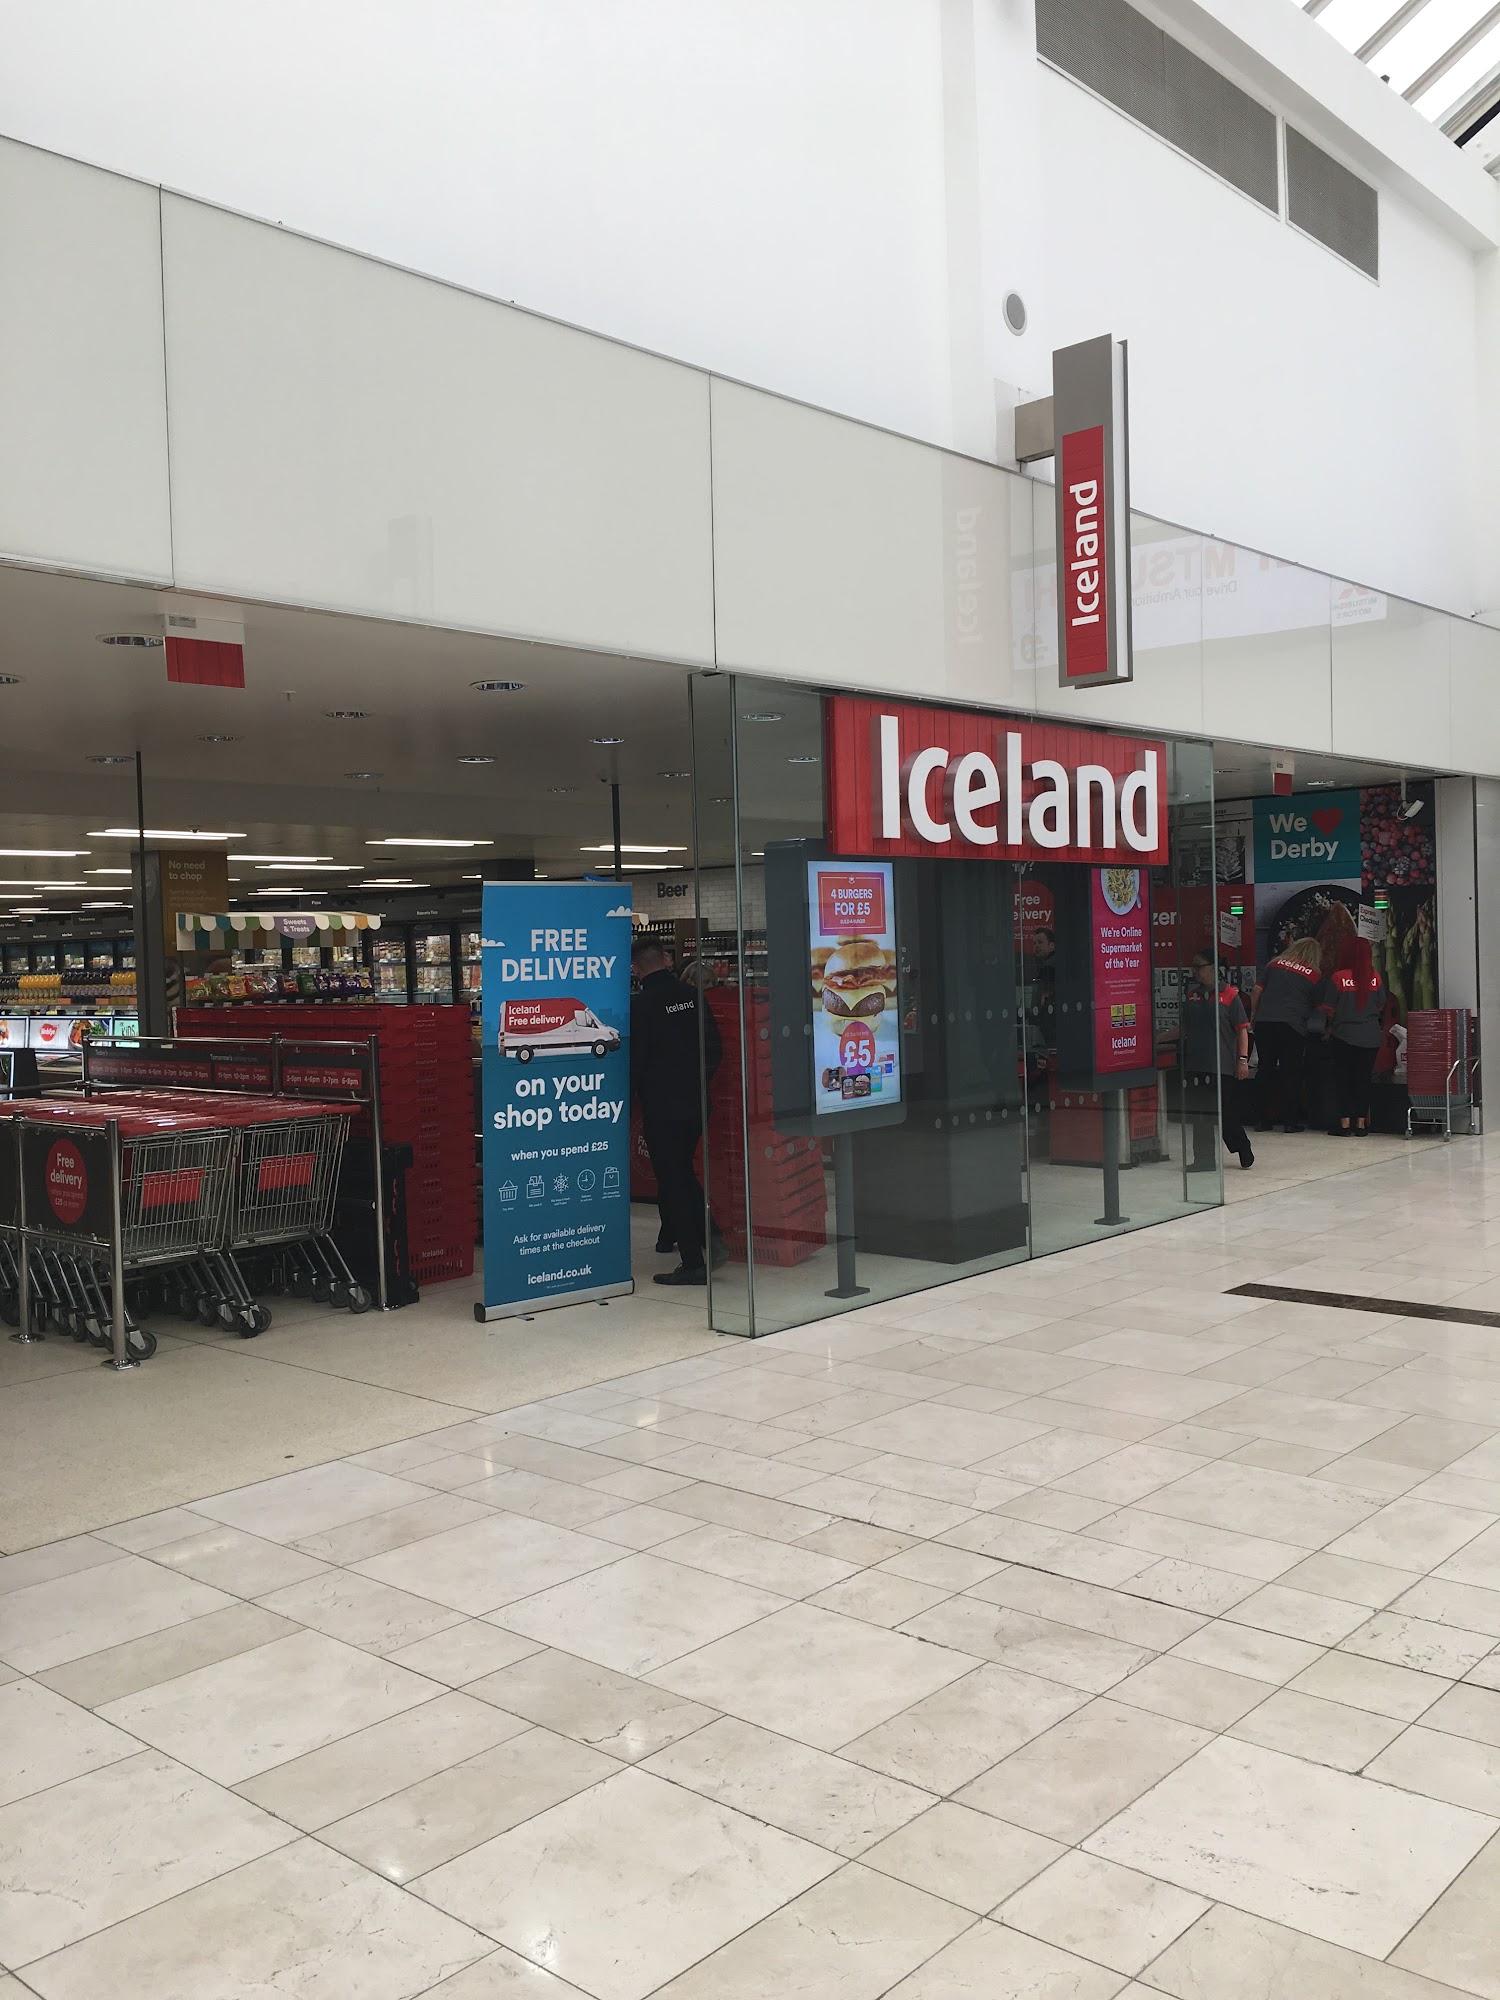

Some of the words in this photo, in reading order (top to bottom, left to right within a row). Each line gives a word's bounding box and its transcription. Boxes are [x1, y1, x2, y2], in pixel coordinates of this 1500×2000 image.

[1069, 479, 1100, 627] Iceland
[876, 714, 1159, 852] Iceland
[1269, 813, 1308, 834] We
[1270, 837, 1339, 861] Derby
[168, 860, 181, 869] No
[184, 861, 205, 870] need
[168, 872, 178, 880] to
[180, 872, 202, 882] chop
[657, 882, 688, 898] Beer
[830, 888, 837, 899] 4
[838, 888, 873, 899] BURGERS
[1014, 893, 1040, 906] Free
[834, 902, 855, 916] FOR
[857, 902, 871, 916] £5
[283, 918, 308, 926] Sweets
[1100, 927, 1120, 938] We're
[1120, 926, 1142, 938] Online
[531, 928, 588, 952] FREE
[1101, 942, 1142, 956] Supermarket
[501, 956, 617, 982] DELIVERY
[1104, 958, 1112, 969] of
[1113, 958, 1124, 968] the
[1124, 957, 1140, 968] Year
[1277, 959, 1313, 975] Iceland
[508, 1004, 540, 1015] Iceland
[665, 1000, 695, 1014] Iceland
[1156, 1002, 1179, 1010] LOOS
[508, 1016, 528, 1026] Free
[530, 1014, 565, 1026] delivery
[1112, 1035, 1136, 1048] Iceland
[210, 1054, 233, 1062] Tomorrow's
[844, 1040, 871, 1068] £5
[323, 1077, 338, 1085] 5-7pm
[342, 1078, 358, 1086] 6-8pm
[515, 1078, 546, 1098] on
[552, 1072, 605, 1100] your
[494, 1104, 553, 1131] shop
[558, 1096, 624, 1124] today
[511, 1150, 539, 1162] when
[541, 1149, 559, 1160] you
[560, 1144, 589, 1158] spend
[592, 1141, 609, 1152] £25
[56, 1152, 75, 1168] Free
[50, 1168, 82, 1190] delivery
[513, 1234, 528, 1245] Ask
[530, 1233, 542, 1242] for
[543, 1228, 576, 1240] available
[577, 1224, 606, 1236] delivery
[422, 1246, 444, 1258] Iceland
[520, 1246, 541, 1256] times
[542, 1244, 550, 1252] at
[552, 1241, 565, 1250] the
[566, 1236, 600, 1248] checkout
[527, 1264, 592, 1285] iceland.co.uk
